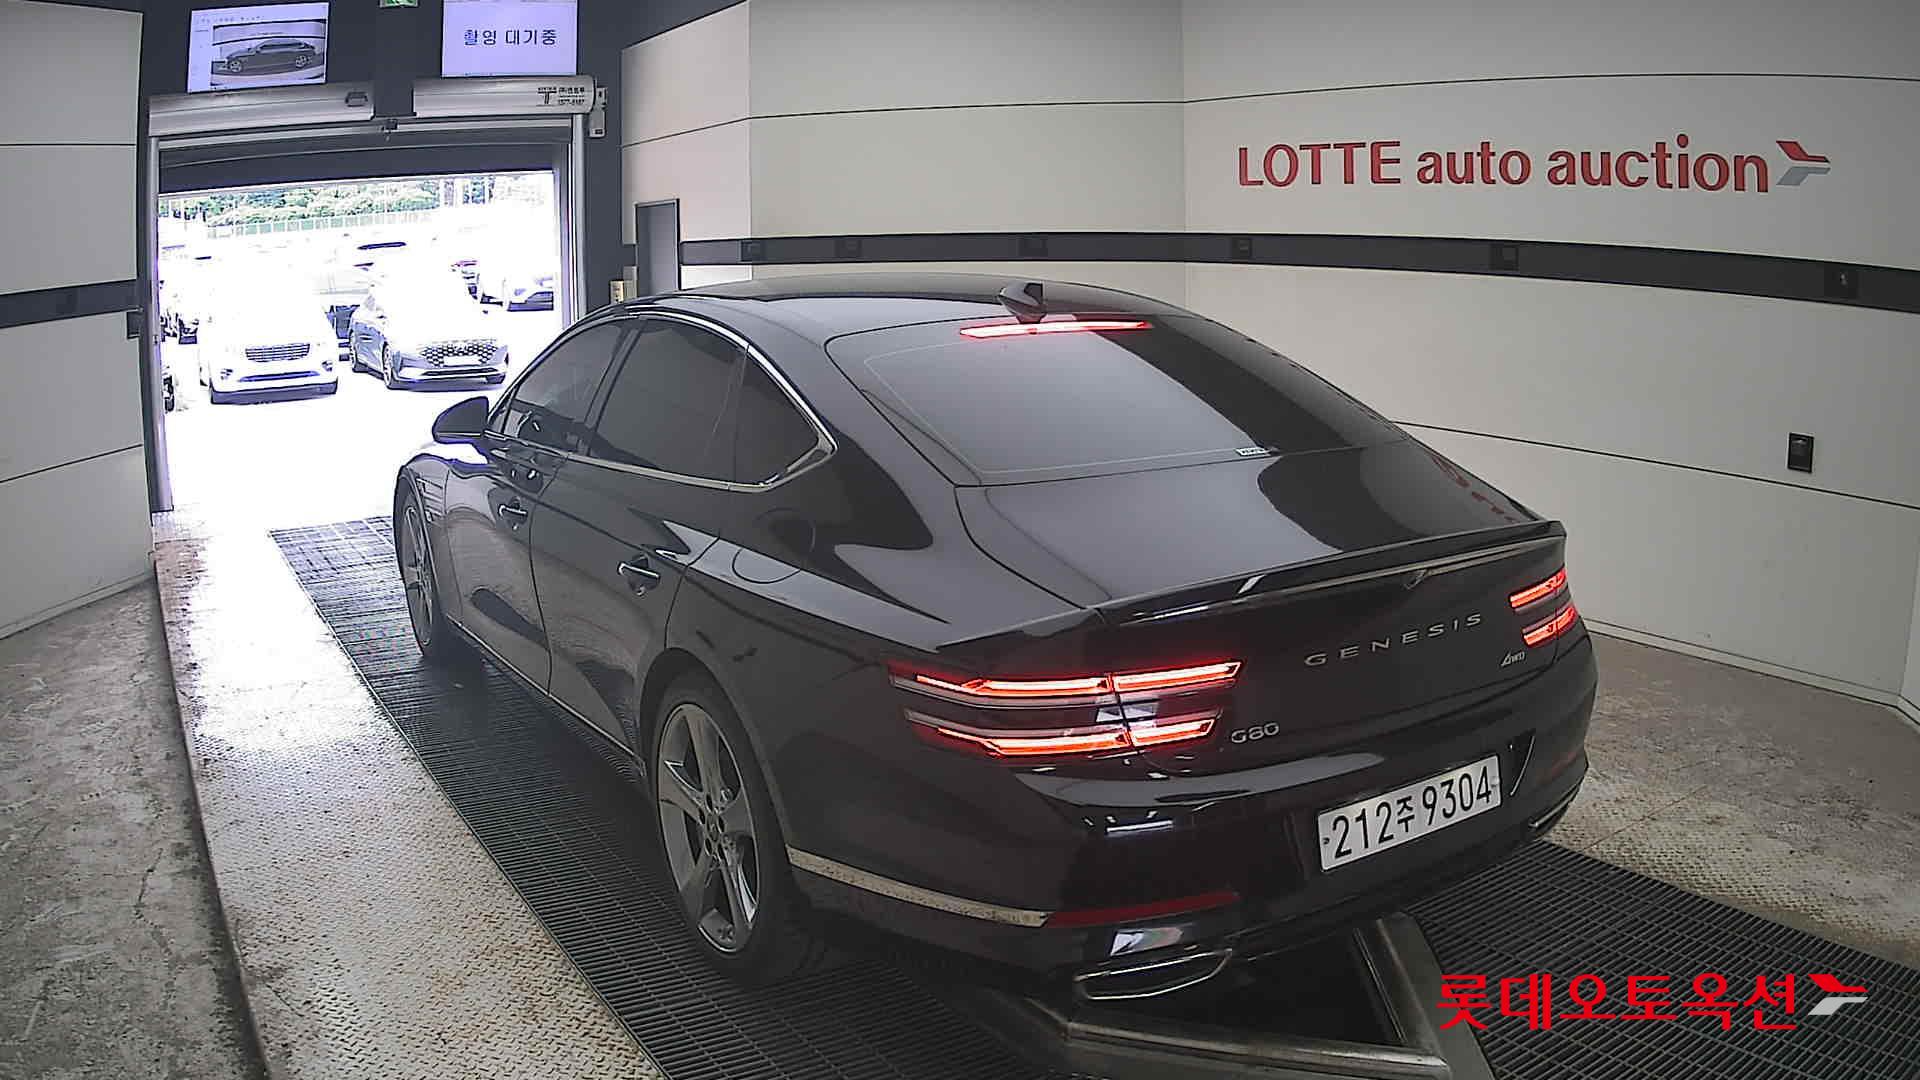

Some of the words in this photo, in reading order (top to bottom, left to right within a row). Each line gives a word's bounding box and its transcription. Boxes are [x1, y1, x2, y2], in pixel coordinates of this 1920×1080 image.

[505, 29, 557, 46] 대기중
[1238, 141, 1400, 187] LOTTE
[1417, 141, 1531, 186] auto
[1547, 134, 1769, 193] auction
[1303, 612, 1483, 667] GENESIS
[1231, 721, 1281, 744] G80
